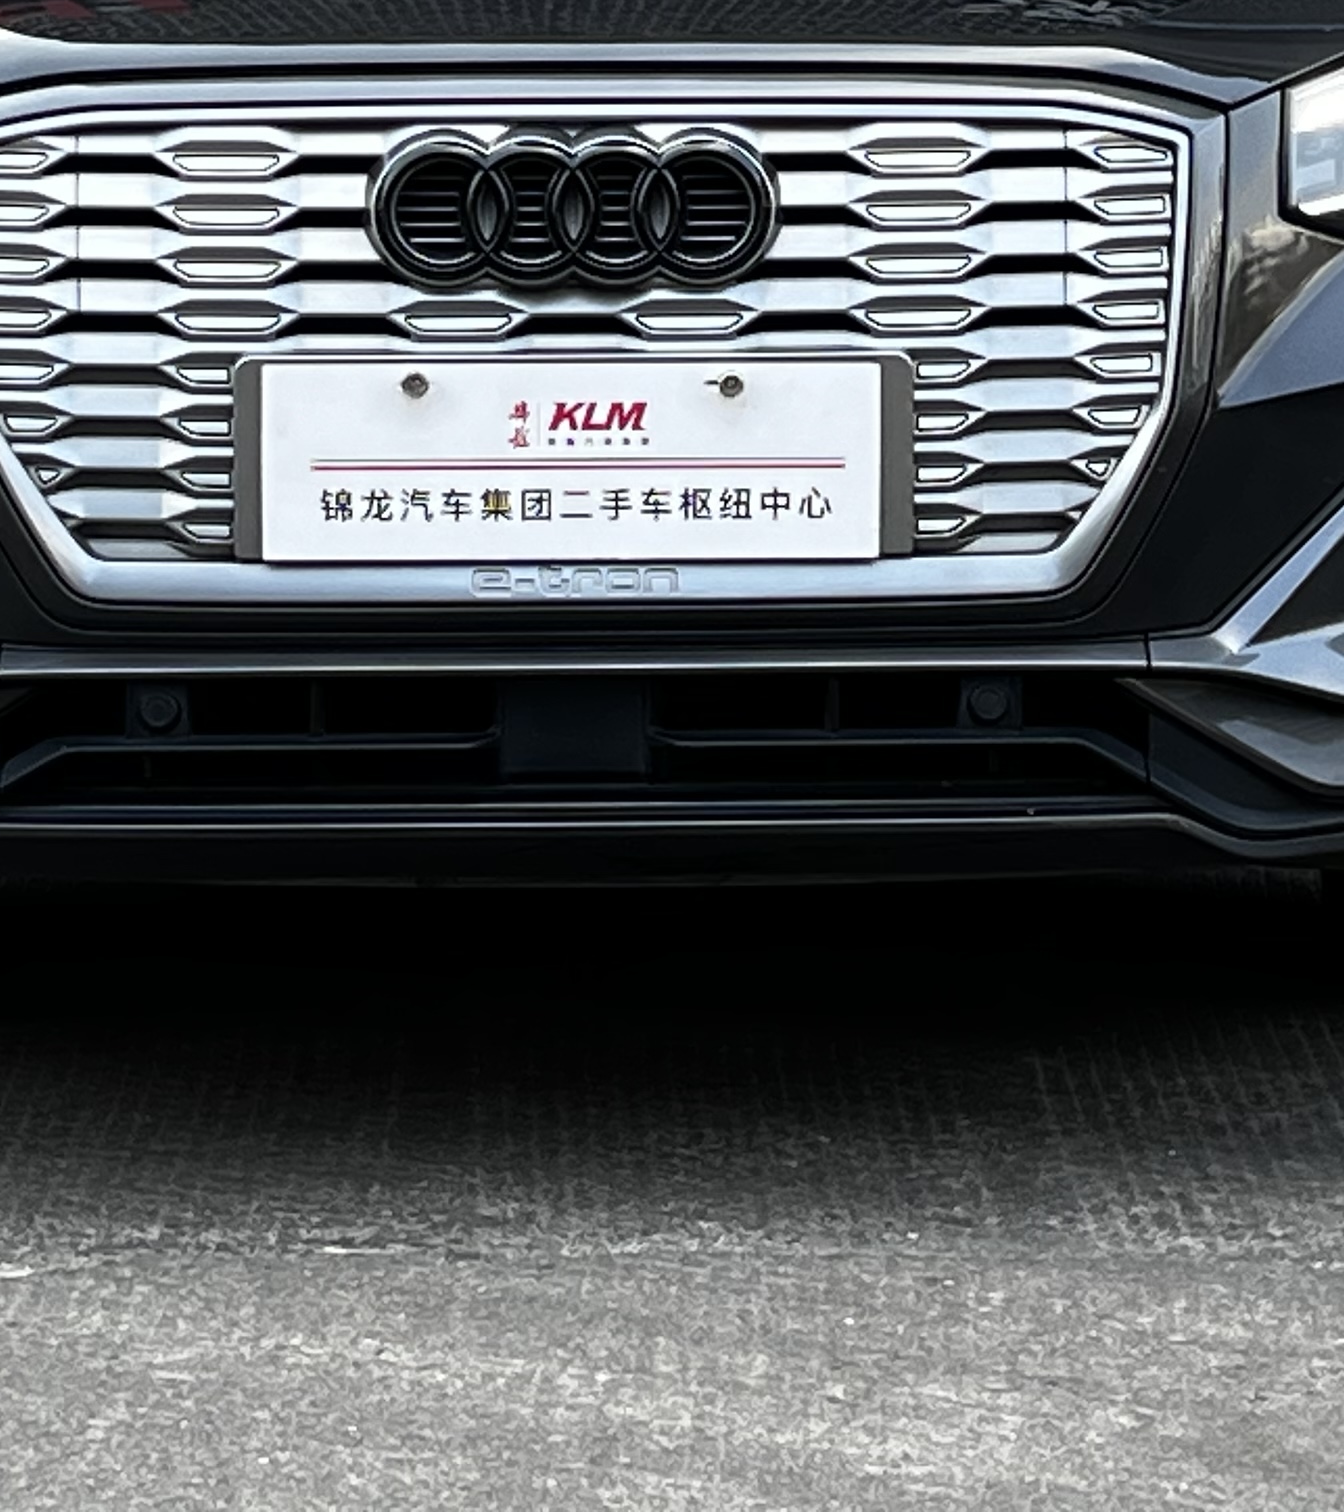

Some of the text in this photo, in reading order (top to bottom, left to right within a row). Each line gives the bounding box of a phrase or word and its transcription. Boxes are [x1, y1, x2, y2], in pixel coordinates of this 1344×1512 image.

[548, 401, 648, 431] KLM
[320, 488, 833, 522] 锦龙汽车集团二手车枢纽中心
[469, 564, 680, 597] e-tron
